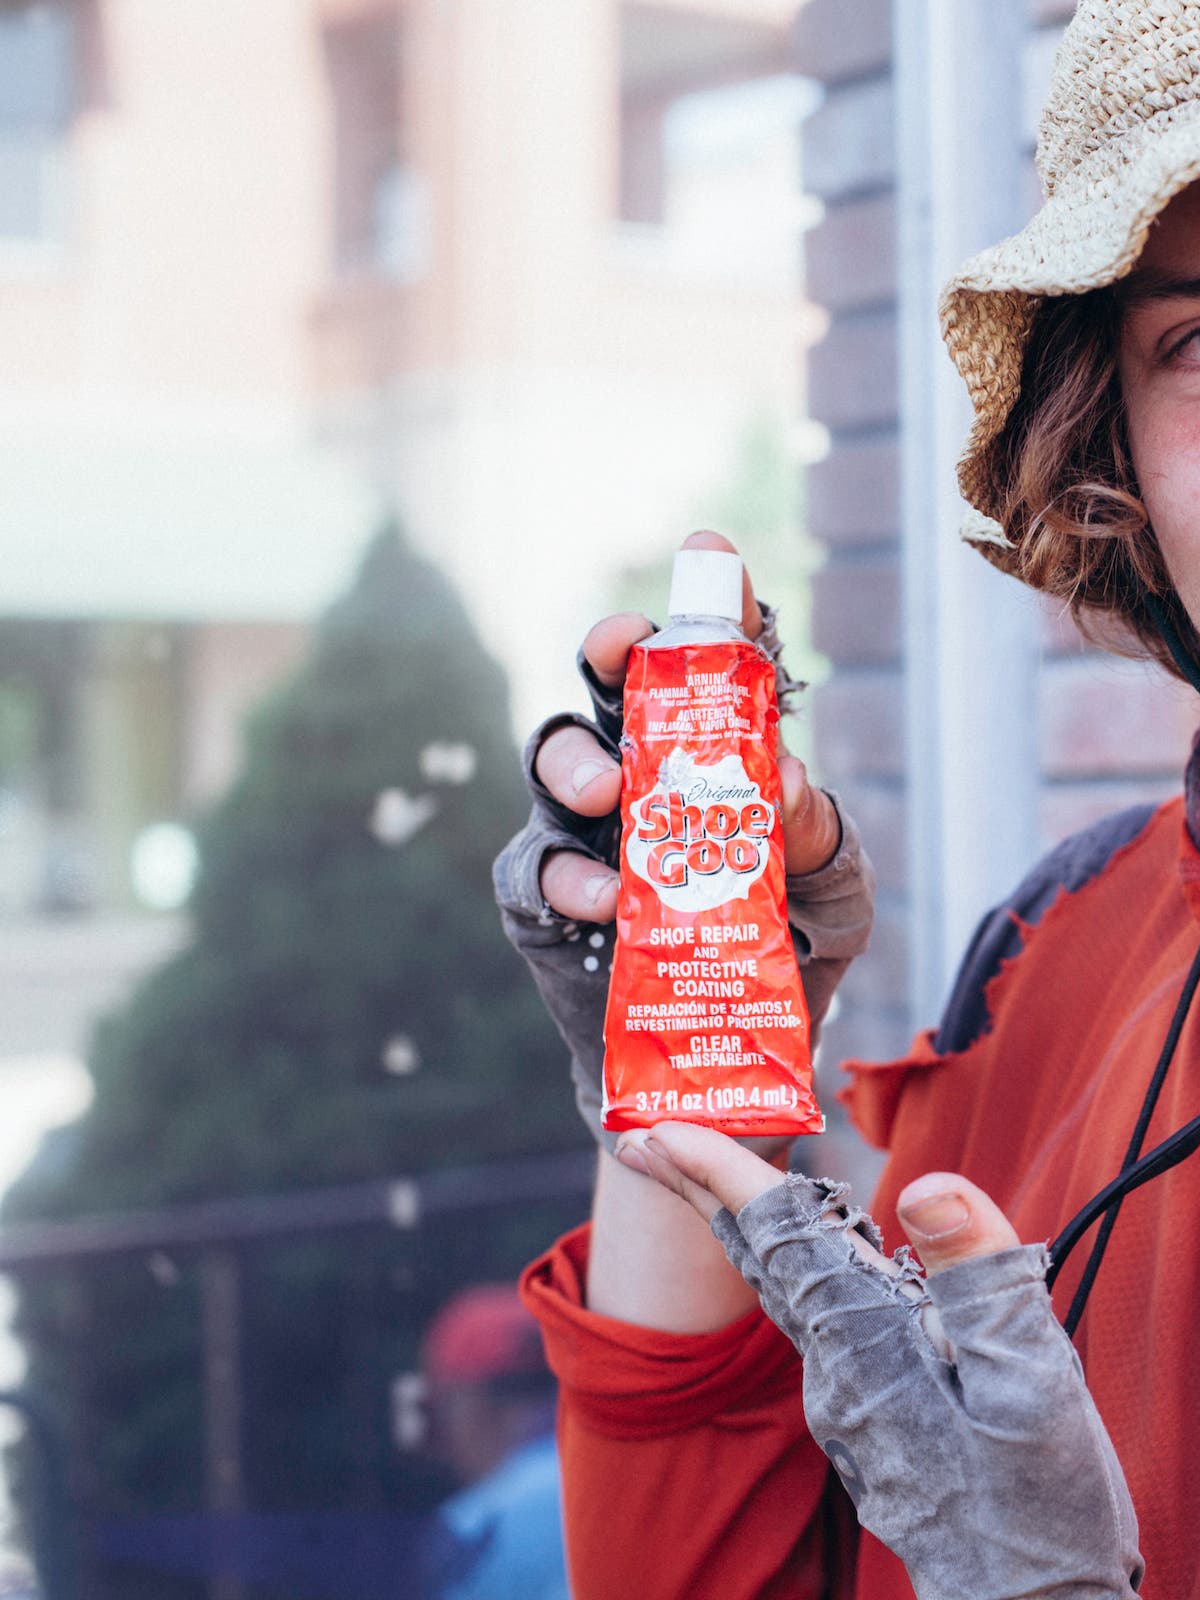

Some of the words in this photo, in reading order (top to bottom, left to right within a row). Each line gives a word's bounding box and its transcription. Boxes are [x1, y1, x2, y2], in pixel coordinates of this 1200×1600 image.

[685, 672, 728, 687] ARNING
[688, 777, 756, 802] Original
[637, 791, 770, 843] Shoe
[647, 839, 761, 889] Goo
[650, 926, 694, 945] SHOE
[701, 924, 759, 943] REPAIR
[693, 947, 719, 959] AND
[657, 960, 758, 978] PROTECTIVE
[672, 980, 745, 998] COATING
[628, 1001, 706, 1017] REPARACIÓN
[710, 1003, 727, 1015] DE
[731, 1001, 782, 1015] ZAPATOS
[783, 1000, 792, 1013] Y
[625, 1015, 723, 1031] REVESTIMIENTO
[690, 1035, 741, 1053] CLEAR
[669, 1052, 766, 1069] TRANSPARENTE
[635, 1091, 660, 1112] 3.7
[665, 1089, 678, 1111] fl
[682, 1093, 703, 1110] oz
[706, 1086, 760, 1113] (109.4
[764, 1084, 798, 1109] mL)
